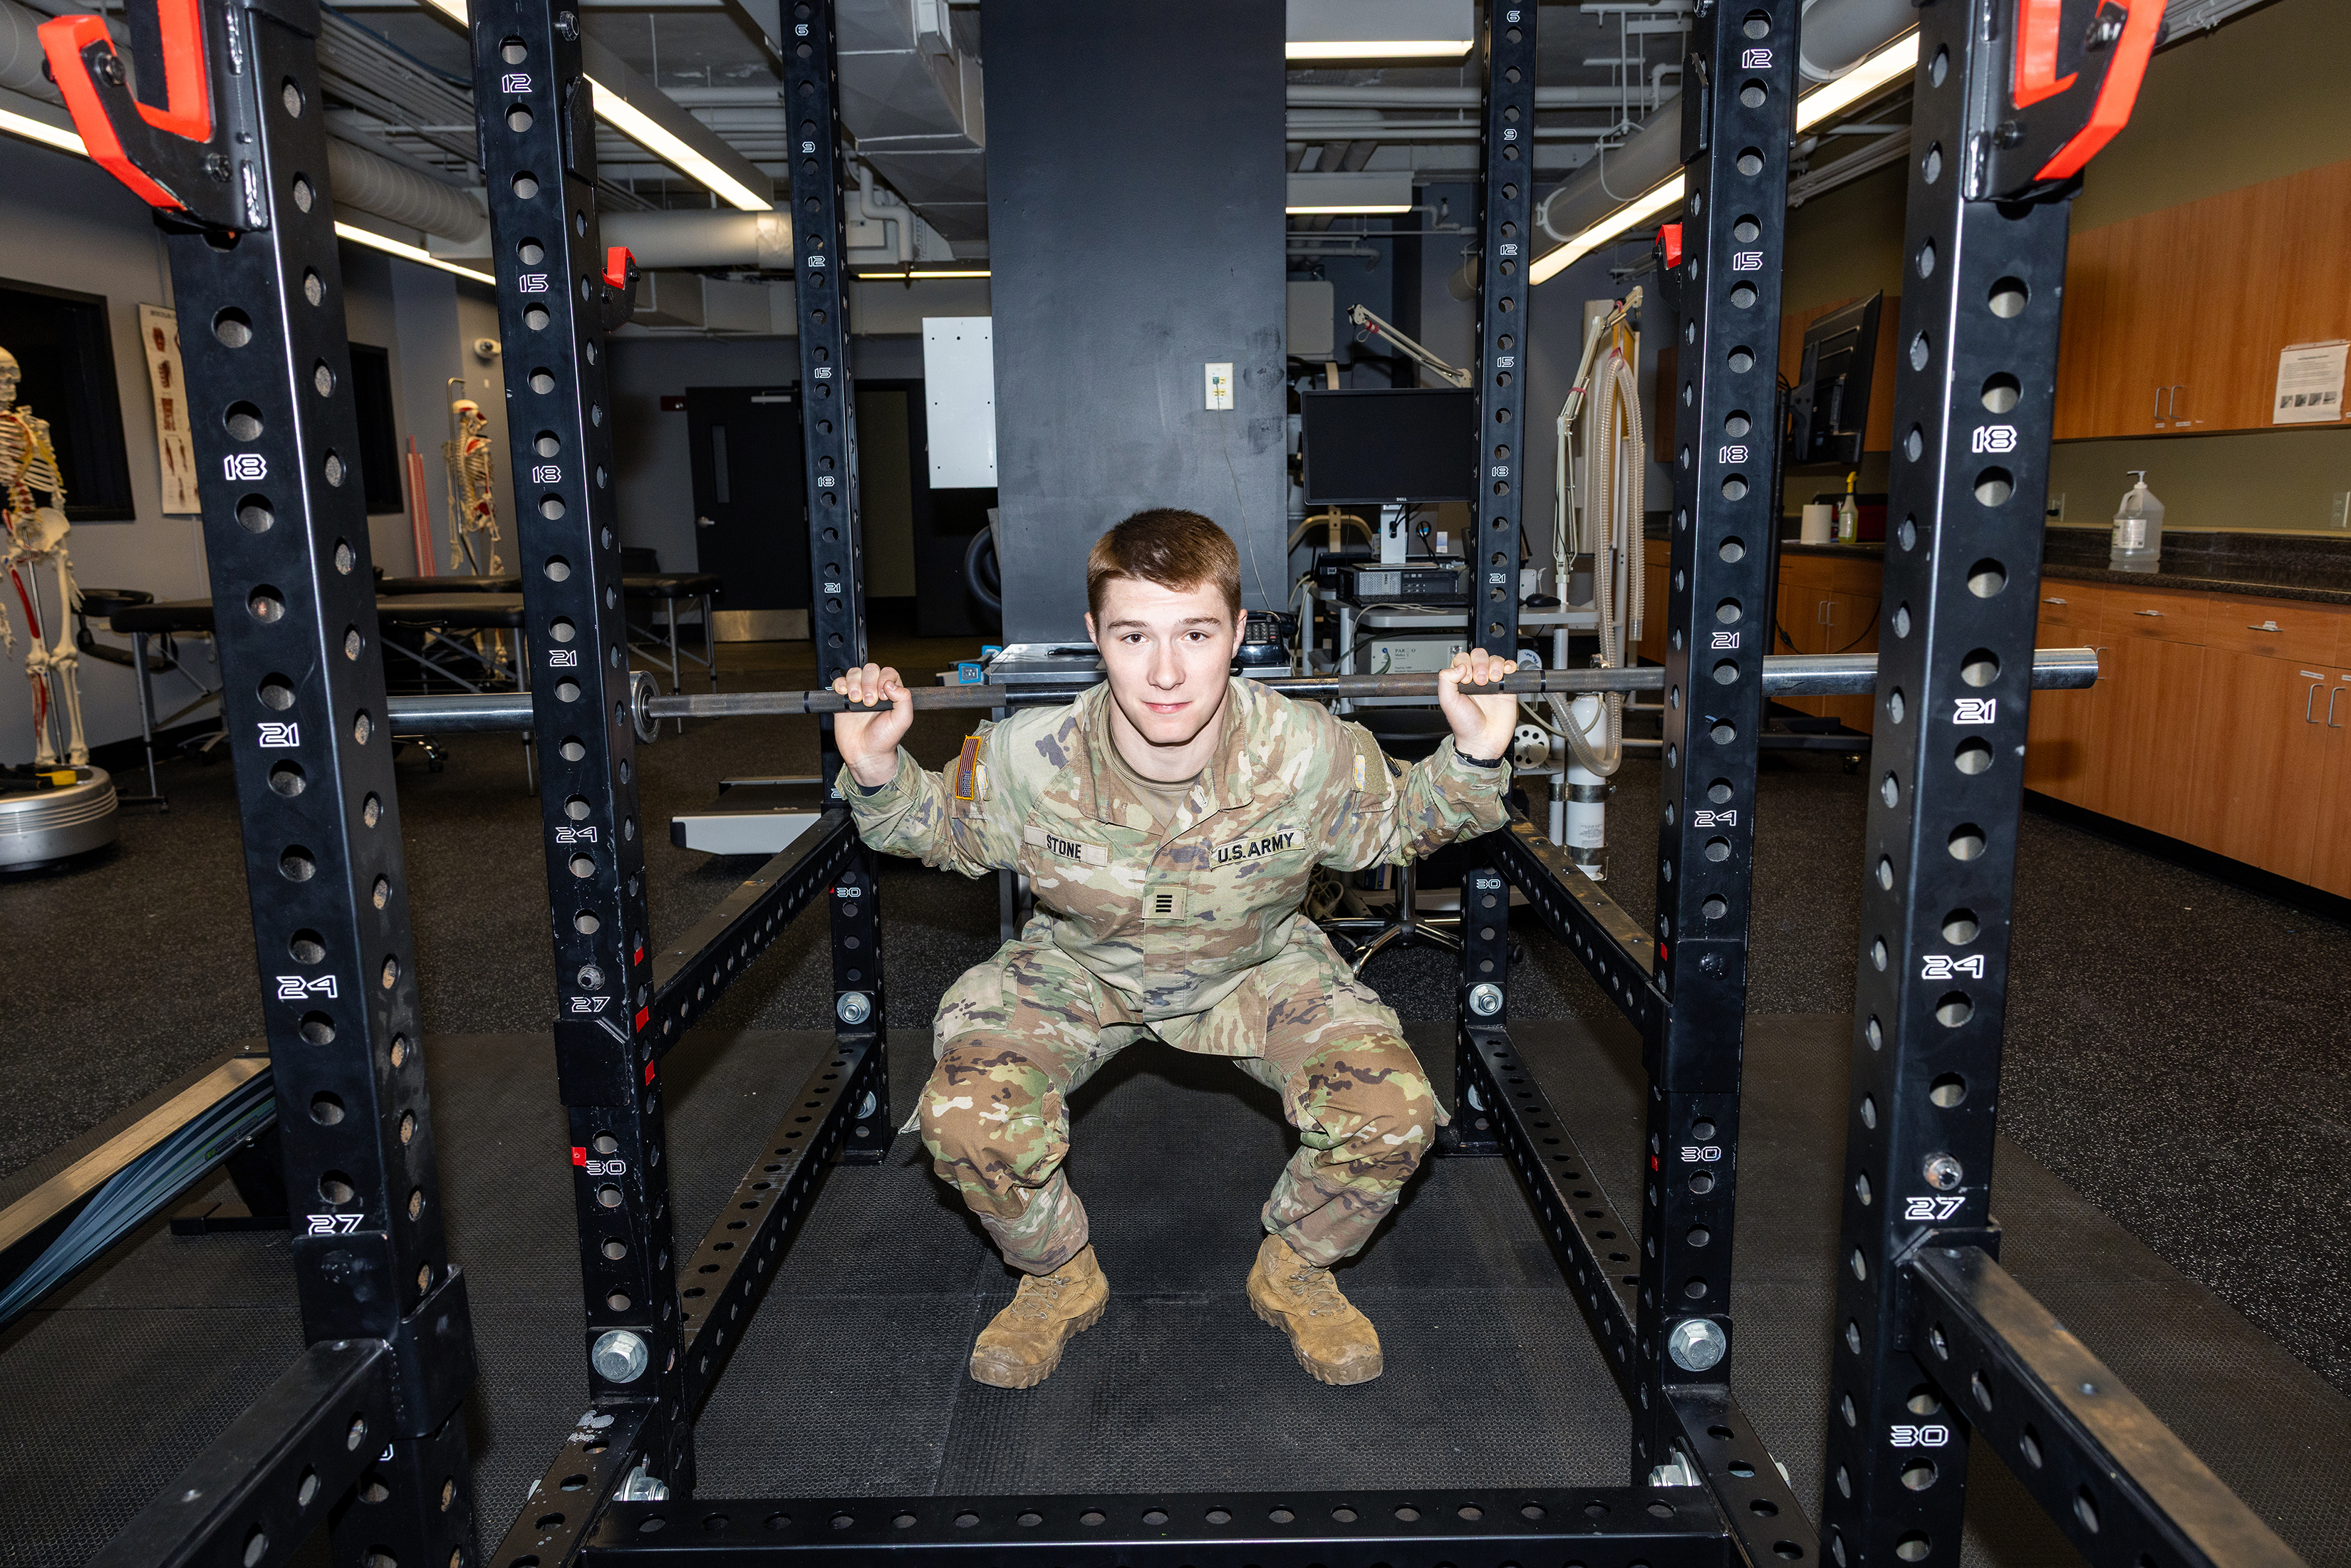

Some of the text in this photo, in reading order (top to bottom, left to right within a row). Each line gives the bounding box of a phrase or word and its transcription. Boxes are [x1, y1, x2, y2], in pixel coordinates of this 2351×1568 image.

[1506, 10, 1520, 23] 6
[794, 24, 809, 36] 6
[1741, 48, 1773, 69] 12
[501, 73, 533, 93] 12
[1503, 128, 1517, 140] 9
[801, 141, 816, 153] 9
[1500, 244, 1518, 256] 12
[808, 255, 826, 267] 12
[1733, 251, 1764, 271] 15
[519, 274, 549, 293] 15
[1497, 356, 1515, 368] 15
[814, 367, 832, 379] 15
[1971, 425, 2018, 454] 18
[1718, 445, 1749, 464] 18
[222, 453, 268, 481] 18
[531, 464, 562, 484] 18
[1491, 465, 1509, 477] 18
[817, 476, 835, 487] 18
[824, 582, 841, 593] 21
[1489, 573, 1506, 584] 21
[1711, 631, 1740, 650] 21
[548, 650, 578, 668] 21
[1952, 697, 1997, 725] 21
[256, 722, 301, 748] 21
[1694, 809, 1737, 828] 24
[555, 826, 598, 845] 24
[1047, 834, 1081, 859] STONE
[836, 887, 861, 898] 30
[1476, 878, 1501, 889] 30
[1921, 954, 1985, 980] 24
[275, 975, 338, 1000] 24
[570, 996, 611, 1013] 27
[1681, 1146, 1722, 1162] 30
[586, 1160, 626, 1175] 30
[1904, 1196, 1966, 1220] 27
[306, 1213, 365, 1235] 27
[1889, 1424, 1949, 1448] 30
